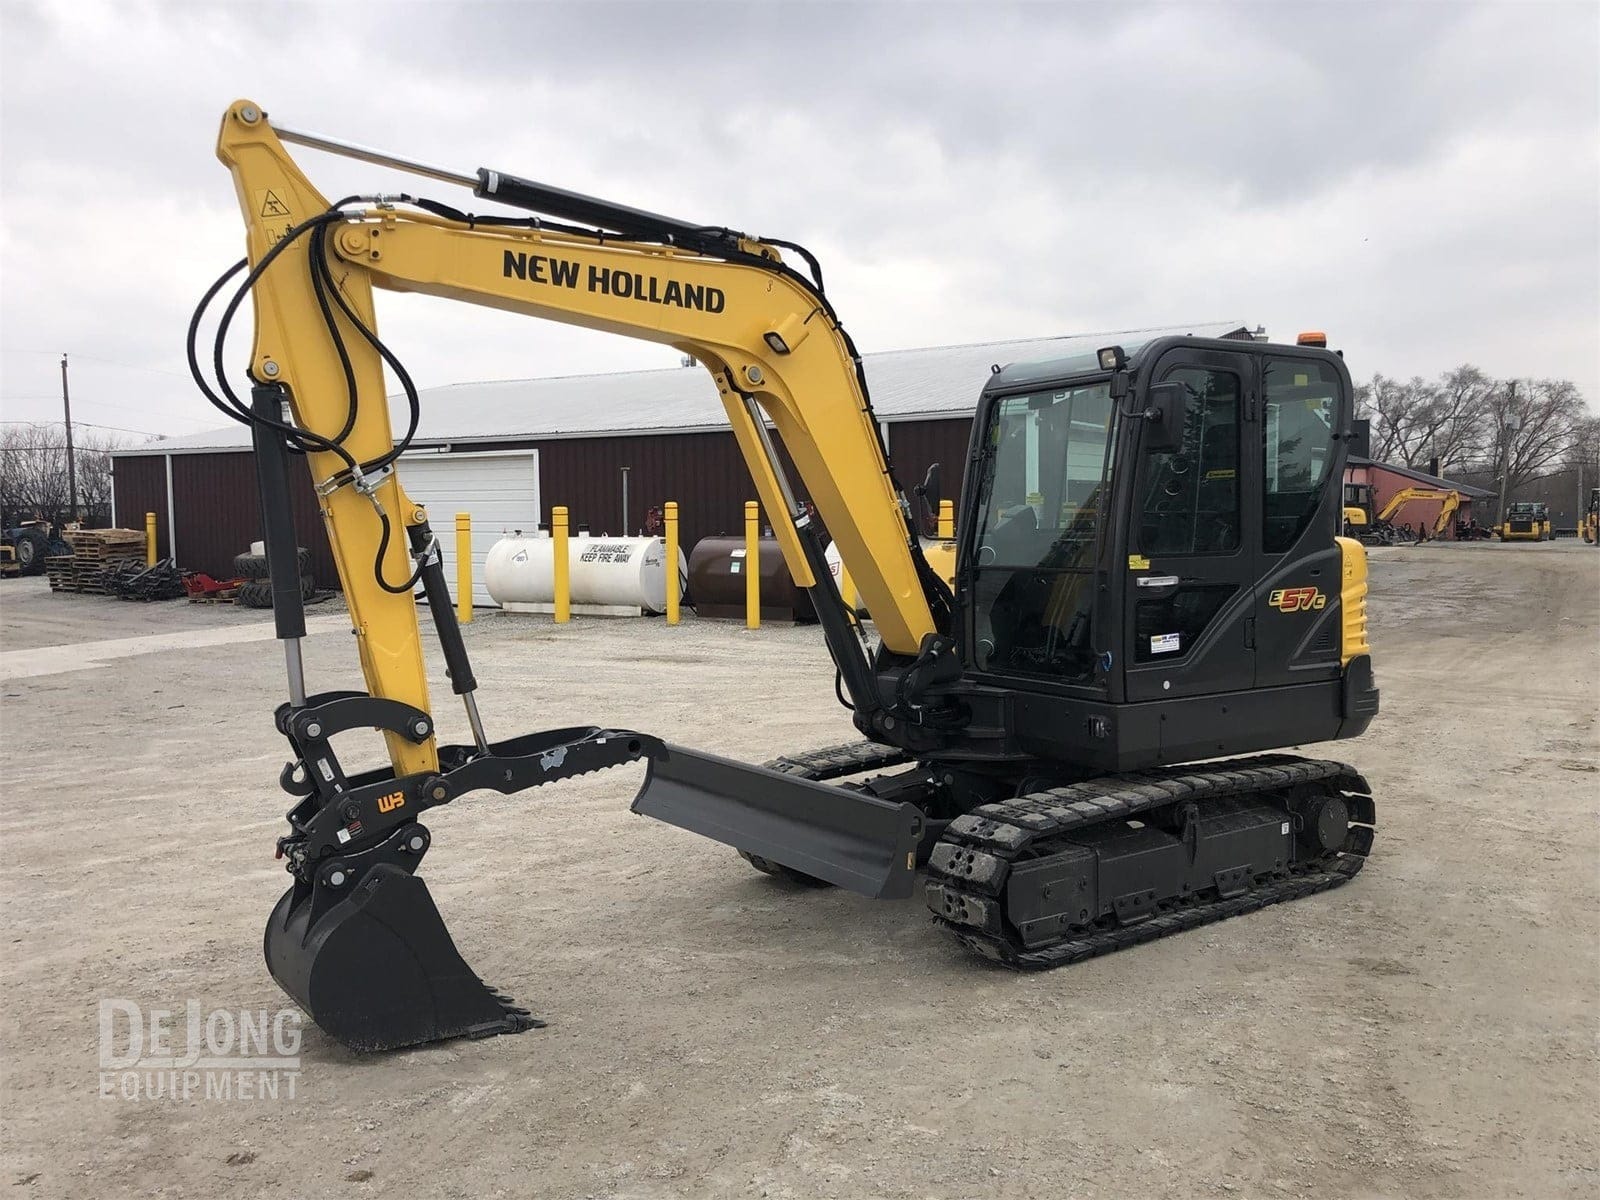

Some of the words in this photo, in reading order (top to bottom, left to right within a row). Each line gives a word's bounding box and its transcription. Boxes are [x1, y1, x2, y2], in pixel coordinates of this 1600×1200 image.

[503, 250, 580, 289] NEW
[588, 265, 725, 314] HOLLAND
[589, 544, 630, 554] FLAMMABLE
[579, 553, 598, 563] KEEP
[598, 553, 613, 564] FIRE
[613, 554, 632, 563] AWAY
